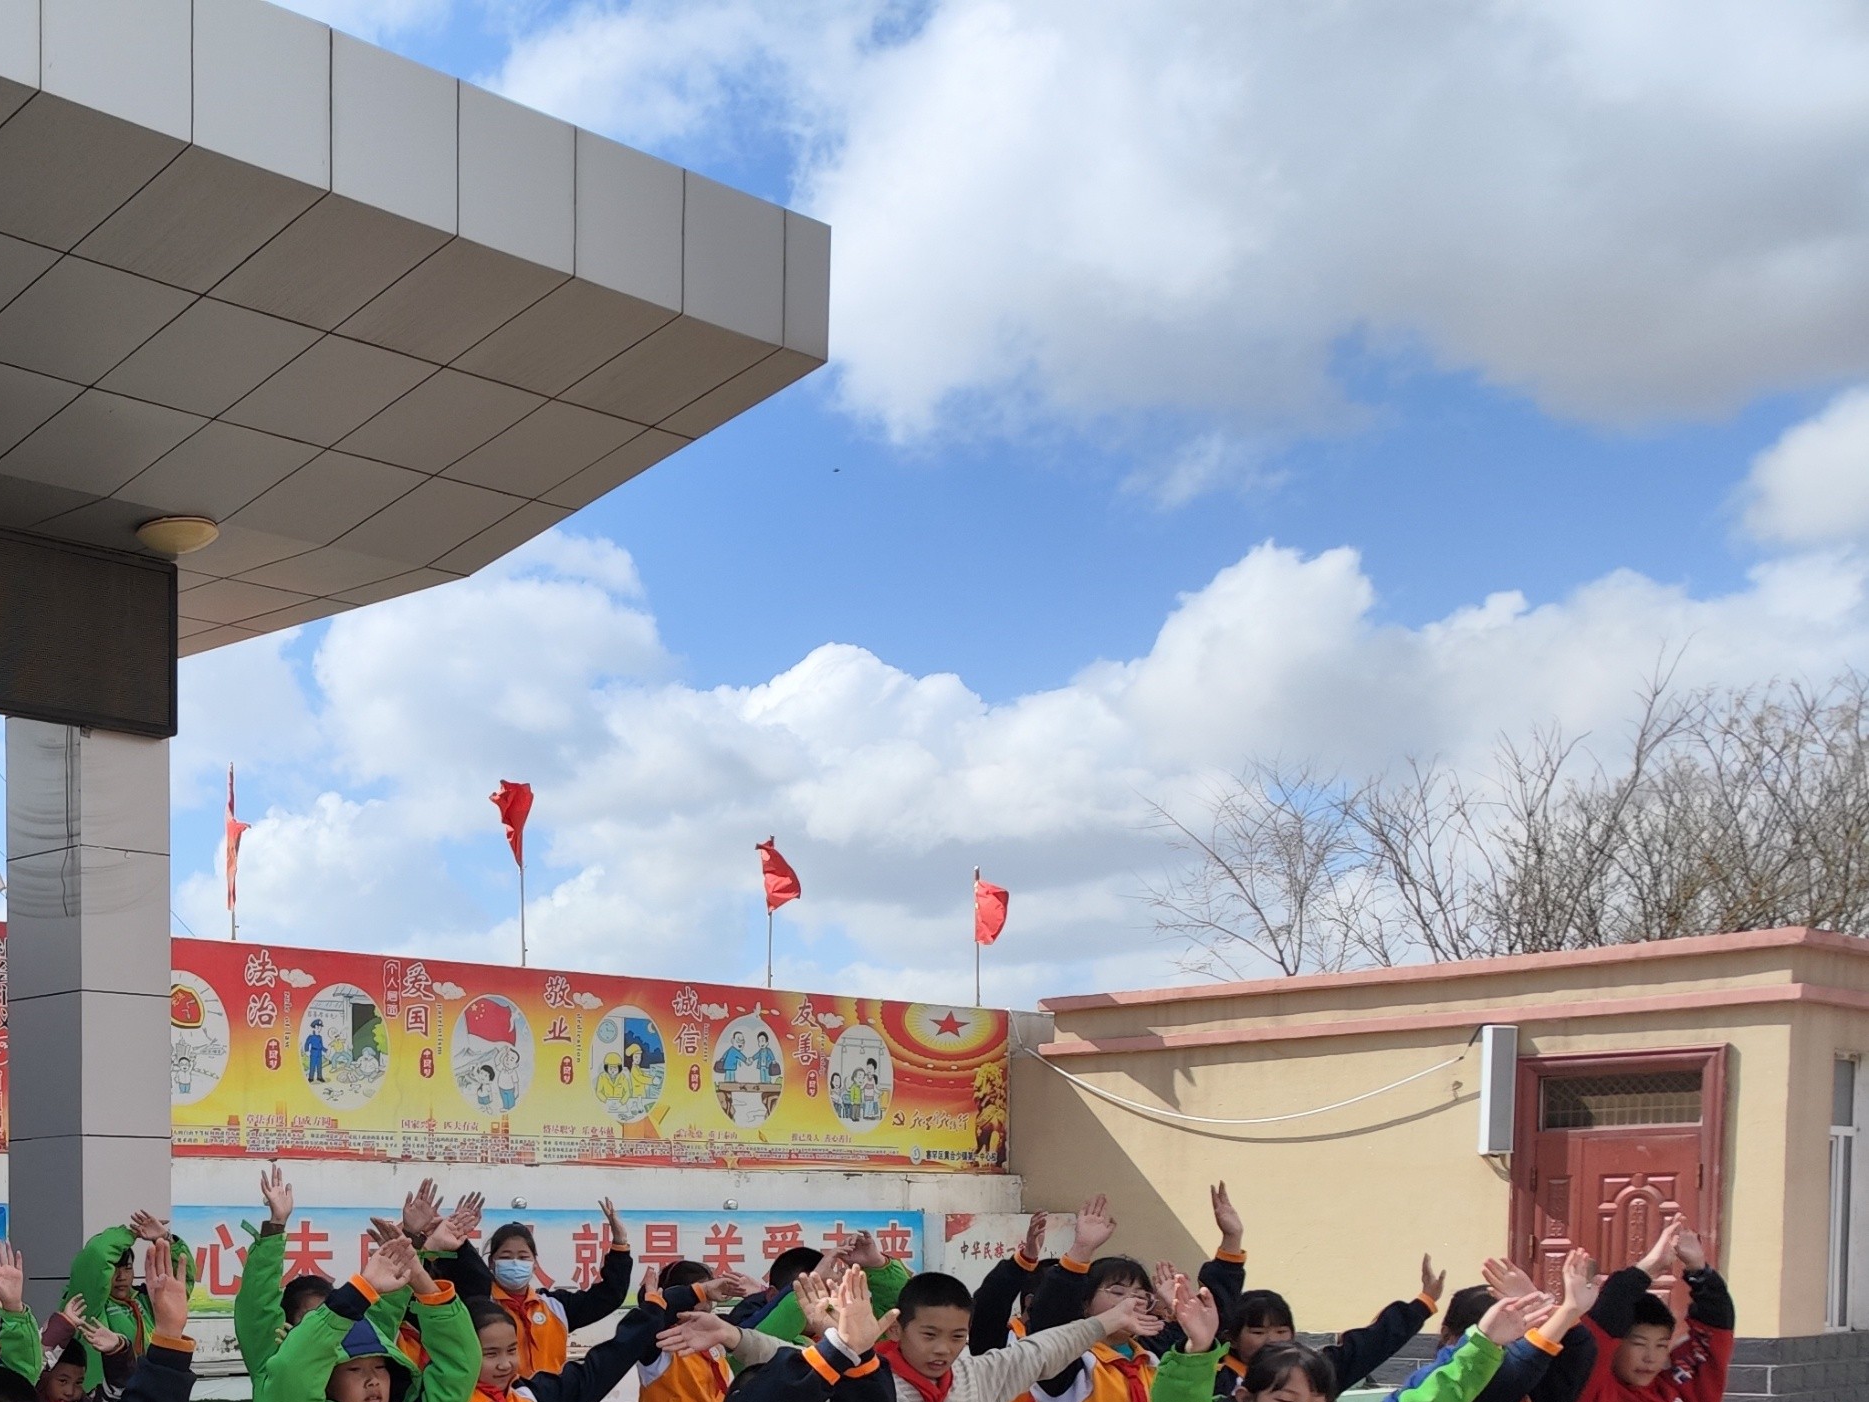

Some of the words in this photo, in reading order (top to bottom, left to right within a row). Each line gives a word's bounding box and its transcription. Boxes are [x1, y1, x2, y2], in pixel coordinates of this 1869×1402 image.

[244, 949, 279, 1028] 法治
[401, 962, 435, 1039] 爱国
[543, 976, 575, 1043] 敬业
[672, 986, 702, 1056] 诚信
[791, 995, 820, 1066] 友善
